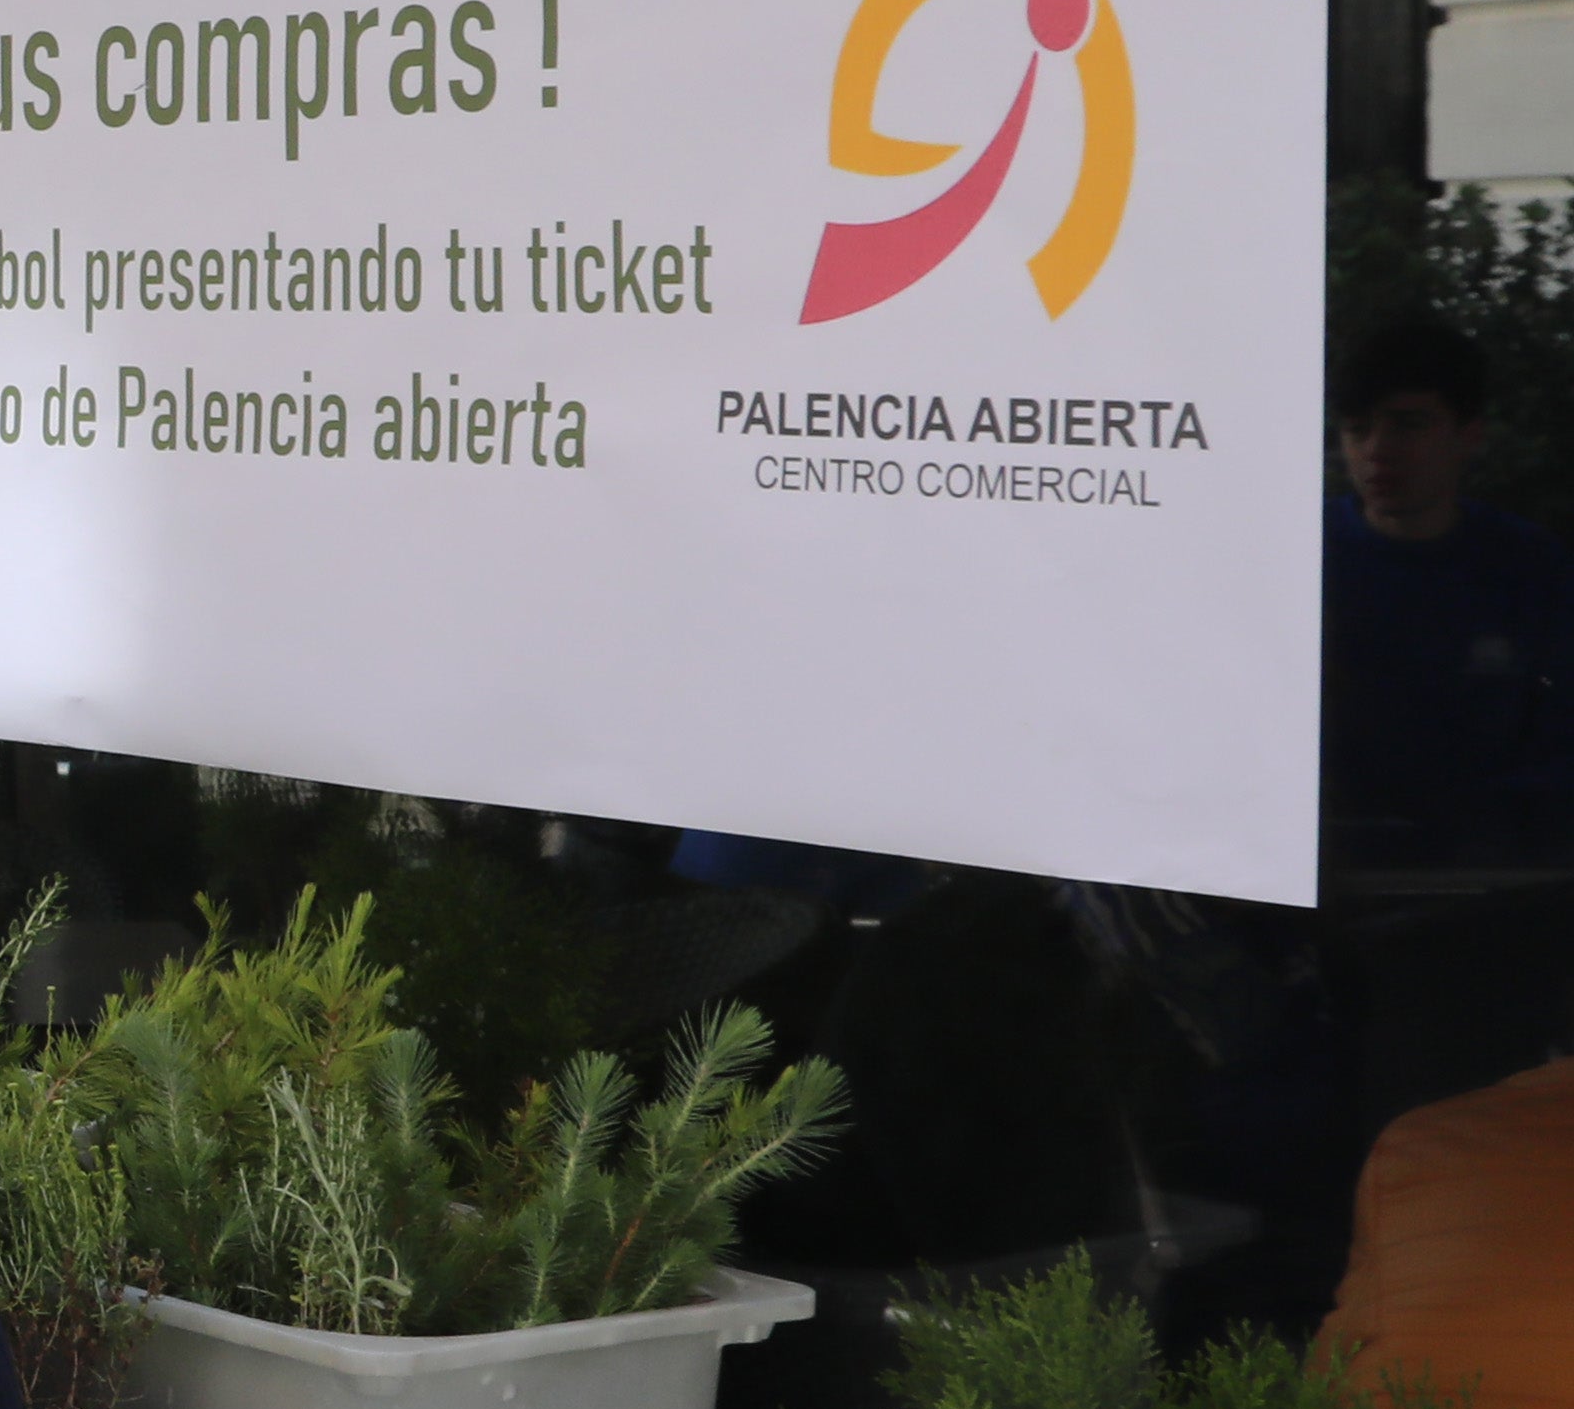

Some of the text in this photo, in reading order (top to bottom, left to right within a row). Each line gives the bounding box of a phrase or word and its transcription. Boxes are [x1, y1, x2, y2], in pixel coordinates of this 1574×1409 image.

[95, 0, 498, 161] compras
[85, 223, 423, 333] presentando
[444, 228, 504, 314] tu
[526, 219, 714, 315] ticket
[42, 365, 97, 448] de
[117, 365, 348, 459] Palencia
[373, 371, 588, 469] abierta
[717, 390, 1210, 451] PALENCIA ABIERTA
[754, 455, 1162, 508] CENTRO COMERCIAL
